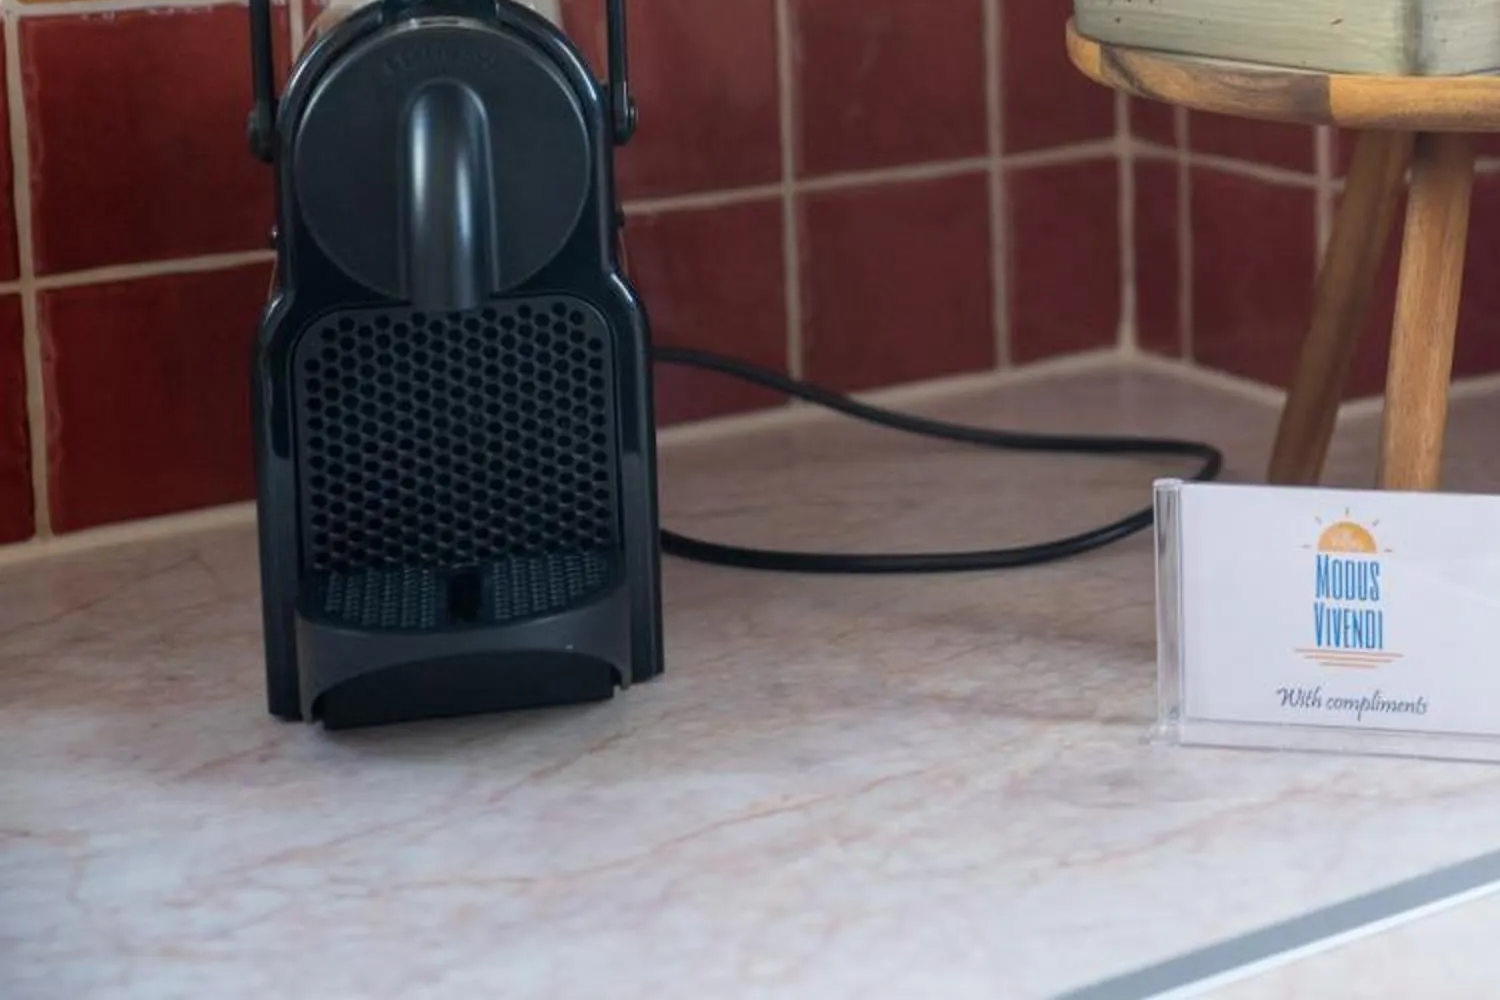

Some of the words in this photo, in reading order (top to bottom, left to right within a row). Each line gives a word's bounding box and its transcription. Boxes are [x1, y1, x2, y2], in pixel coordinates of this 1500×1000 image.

[1315, 553, 1380, 602] MODUS
[1314, 602, 1383, 650] VIVENDI
[1276, 685, 1323, 709] With
[1325, 689, 1429, 722] compliments
